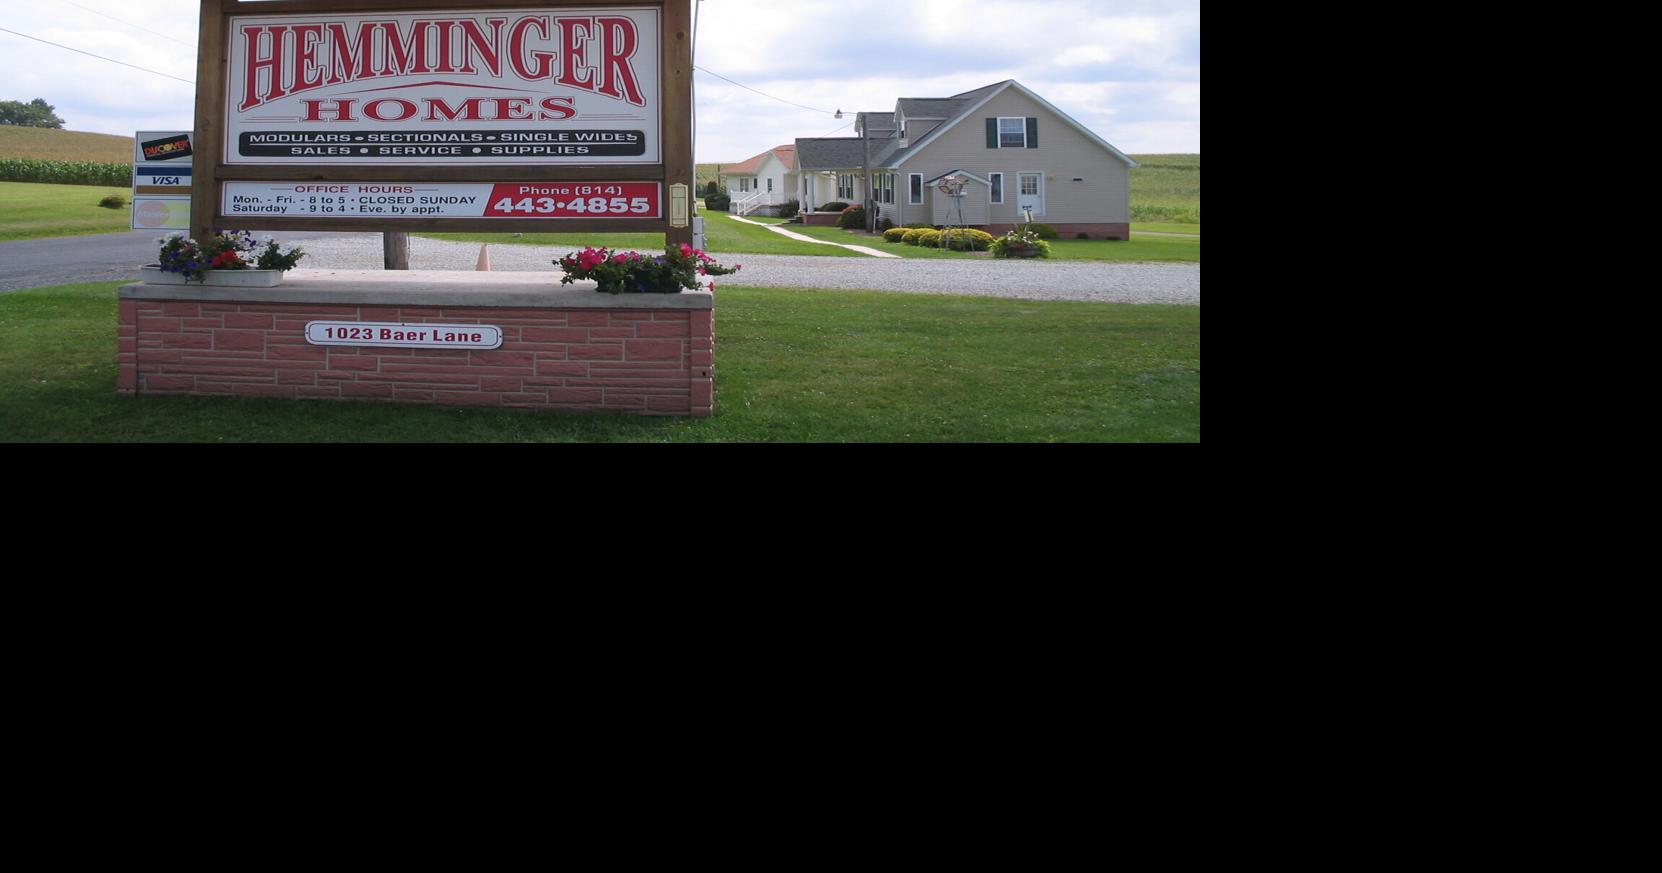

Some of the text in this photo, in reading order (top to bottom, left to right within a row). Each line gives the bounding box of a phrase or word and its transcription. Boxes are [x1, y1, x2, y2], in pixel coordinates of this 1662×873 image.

[238, 15, 646, 111] HEMMINGER
[299, 96, 581, 122] HOMES
[249, 132, 638, 143] MODULARS SECTIONALS SINGLE WIDES
[291, 146, 589, 155] SALES SERVICE SUPPLIES
[152, 176, 180, 185] VISA
[294, 185, 413, 194] OFFICE HOURS
[519, 186, 622, 196] Phone (814)
[233, 195, 263, 204] Mon.
[276, 195, 296, 204] Fri.
[309, 195, 316, 204] 8
[321, 195, 332, 204] to
[338, 195, 345, 204] 5
[359, 196, 415, 204] CLOSED
[420, 196, 476, 204] SUNDAY
[233, 204, 288, 214] Saturday
[309, 205, 316, 213] 9
[321, 205, 332, 213] to
[338, 205, 345, 213] 4
[359, 205, 386, 213] Eve.
[392, 205, 406, 214] by
[411, 205, 444, 214] appt.
[325, 327, 482, 343] 1023 Baer Lane
